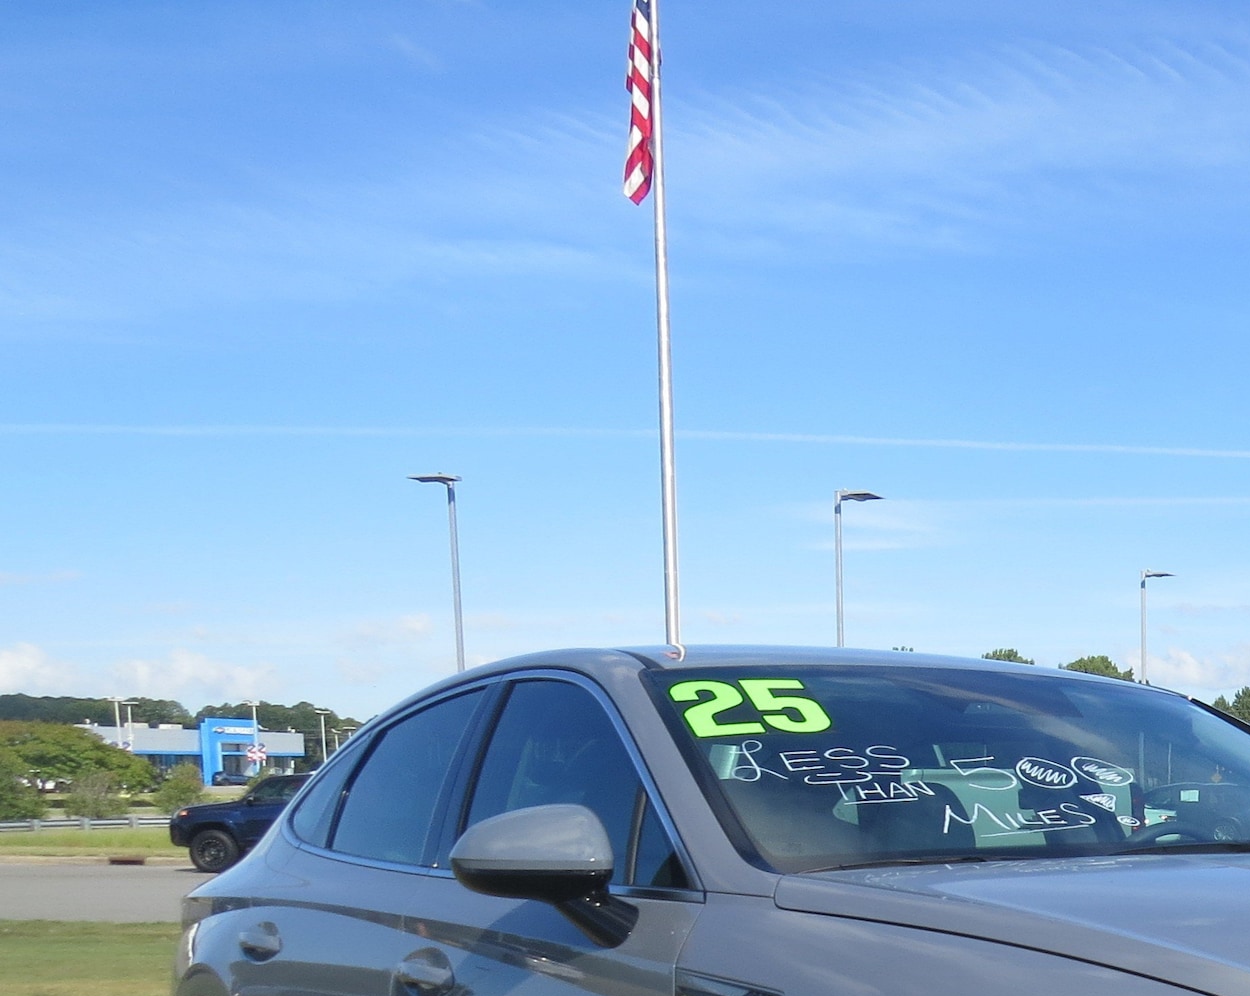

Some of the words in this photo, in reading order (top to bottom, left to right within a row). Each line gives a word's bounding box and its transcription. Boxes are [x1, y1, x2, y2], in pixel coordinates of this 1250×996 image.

[668, 678, 832, 738] 25
[730, 740, 910, 782] LESS
[804, 771, 935, 800] THAN
